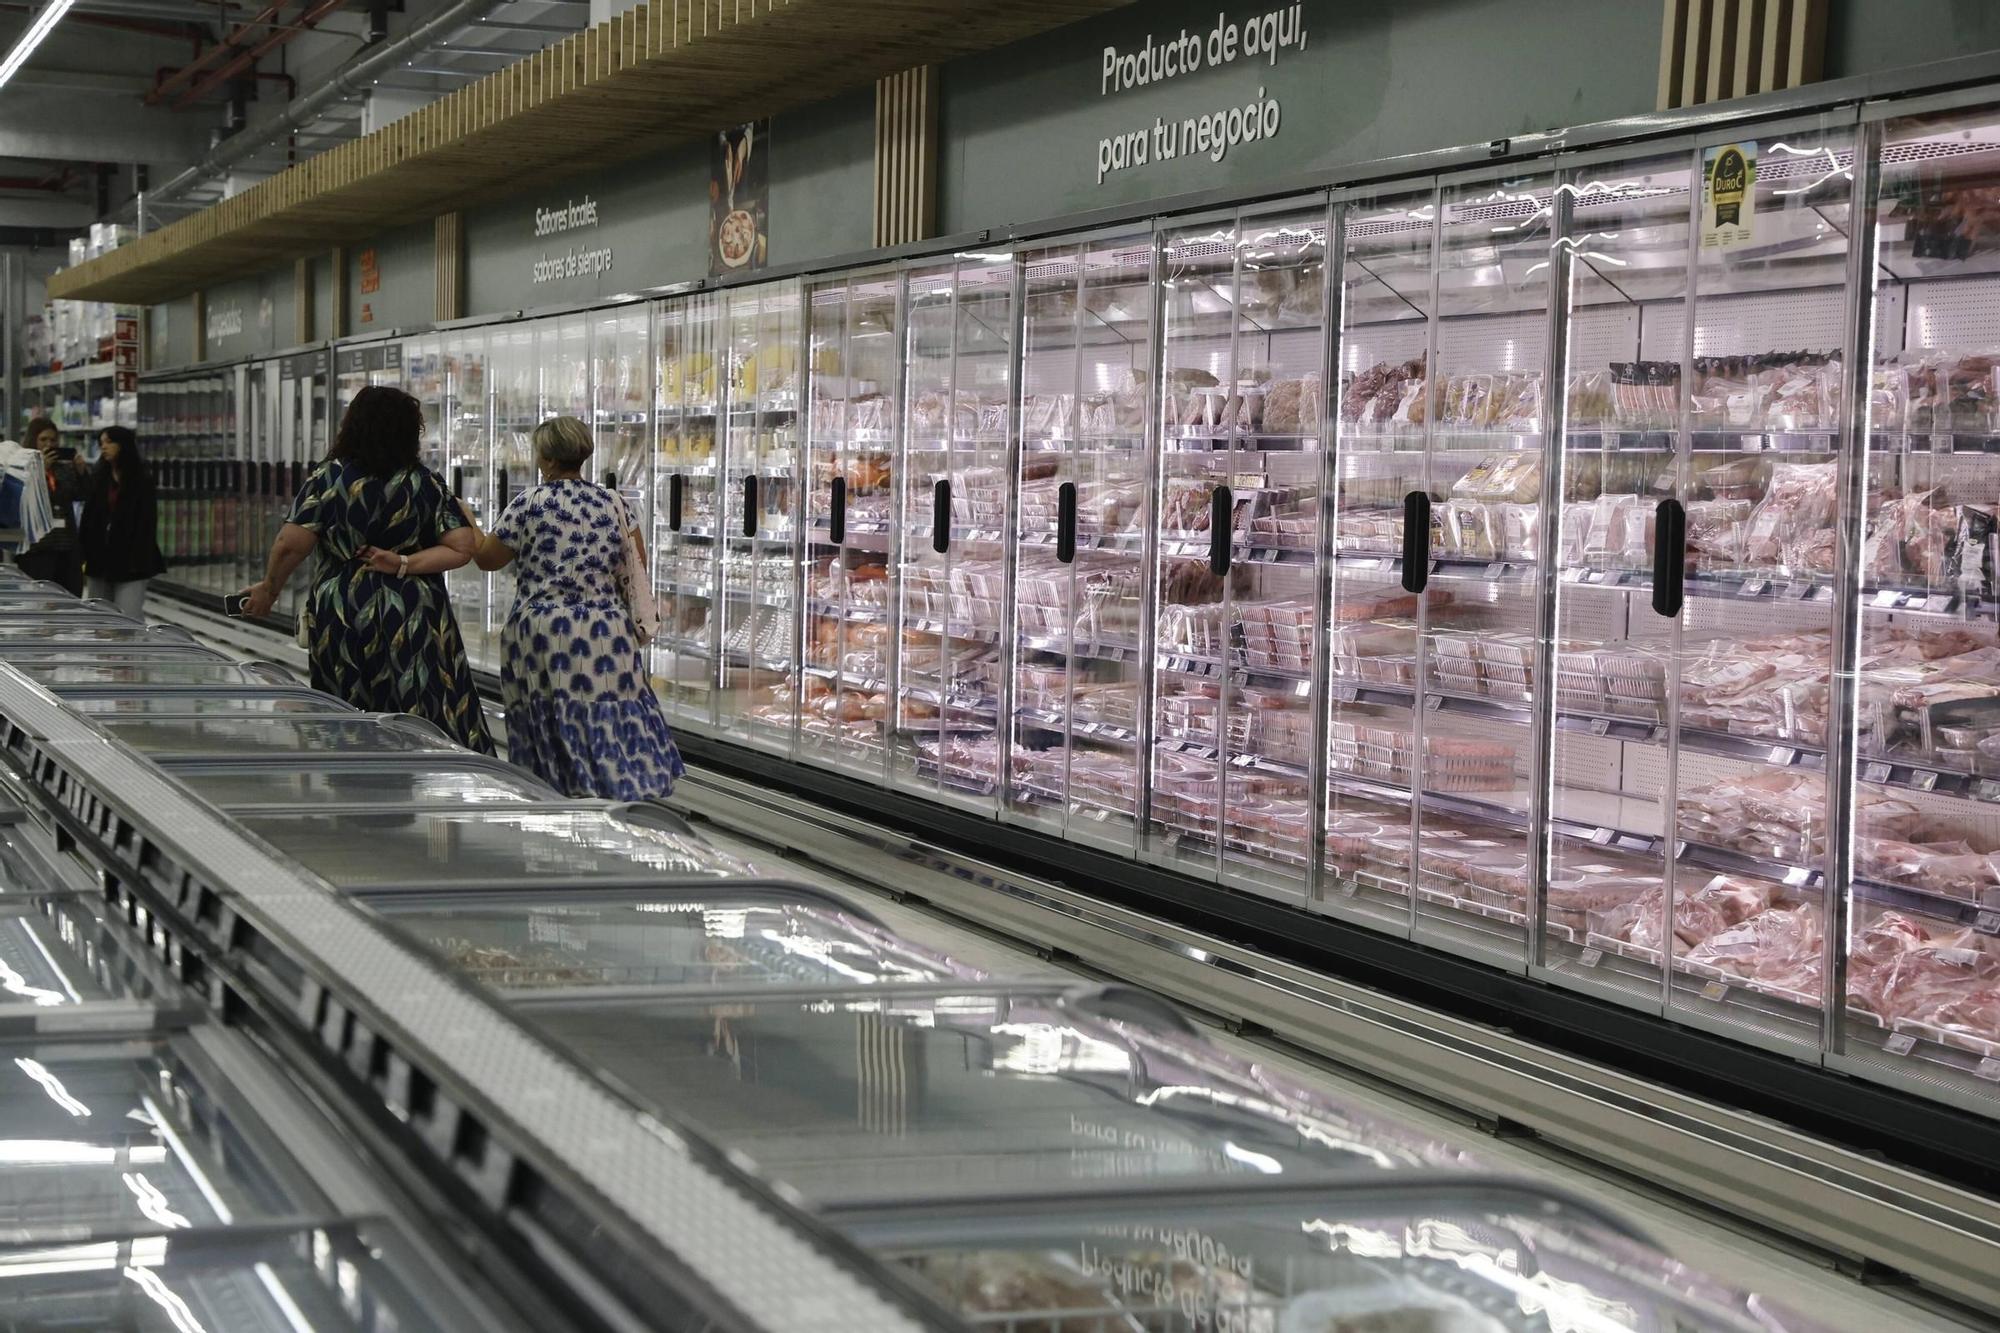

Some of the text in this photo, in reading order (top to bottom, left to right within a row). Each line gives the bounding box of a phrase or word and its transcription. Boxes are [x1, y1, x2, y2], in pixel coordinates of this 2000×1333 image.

[1102, 29, 1202, 95] Producto
[1207, 12, 1239, 67] de
[1097, 87, 1281, 184] para tu negocio
[535, 195, 599, 237] Sabores locales,
[534, 244, 612, 283] sabores de siempre
